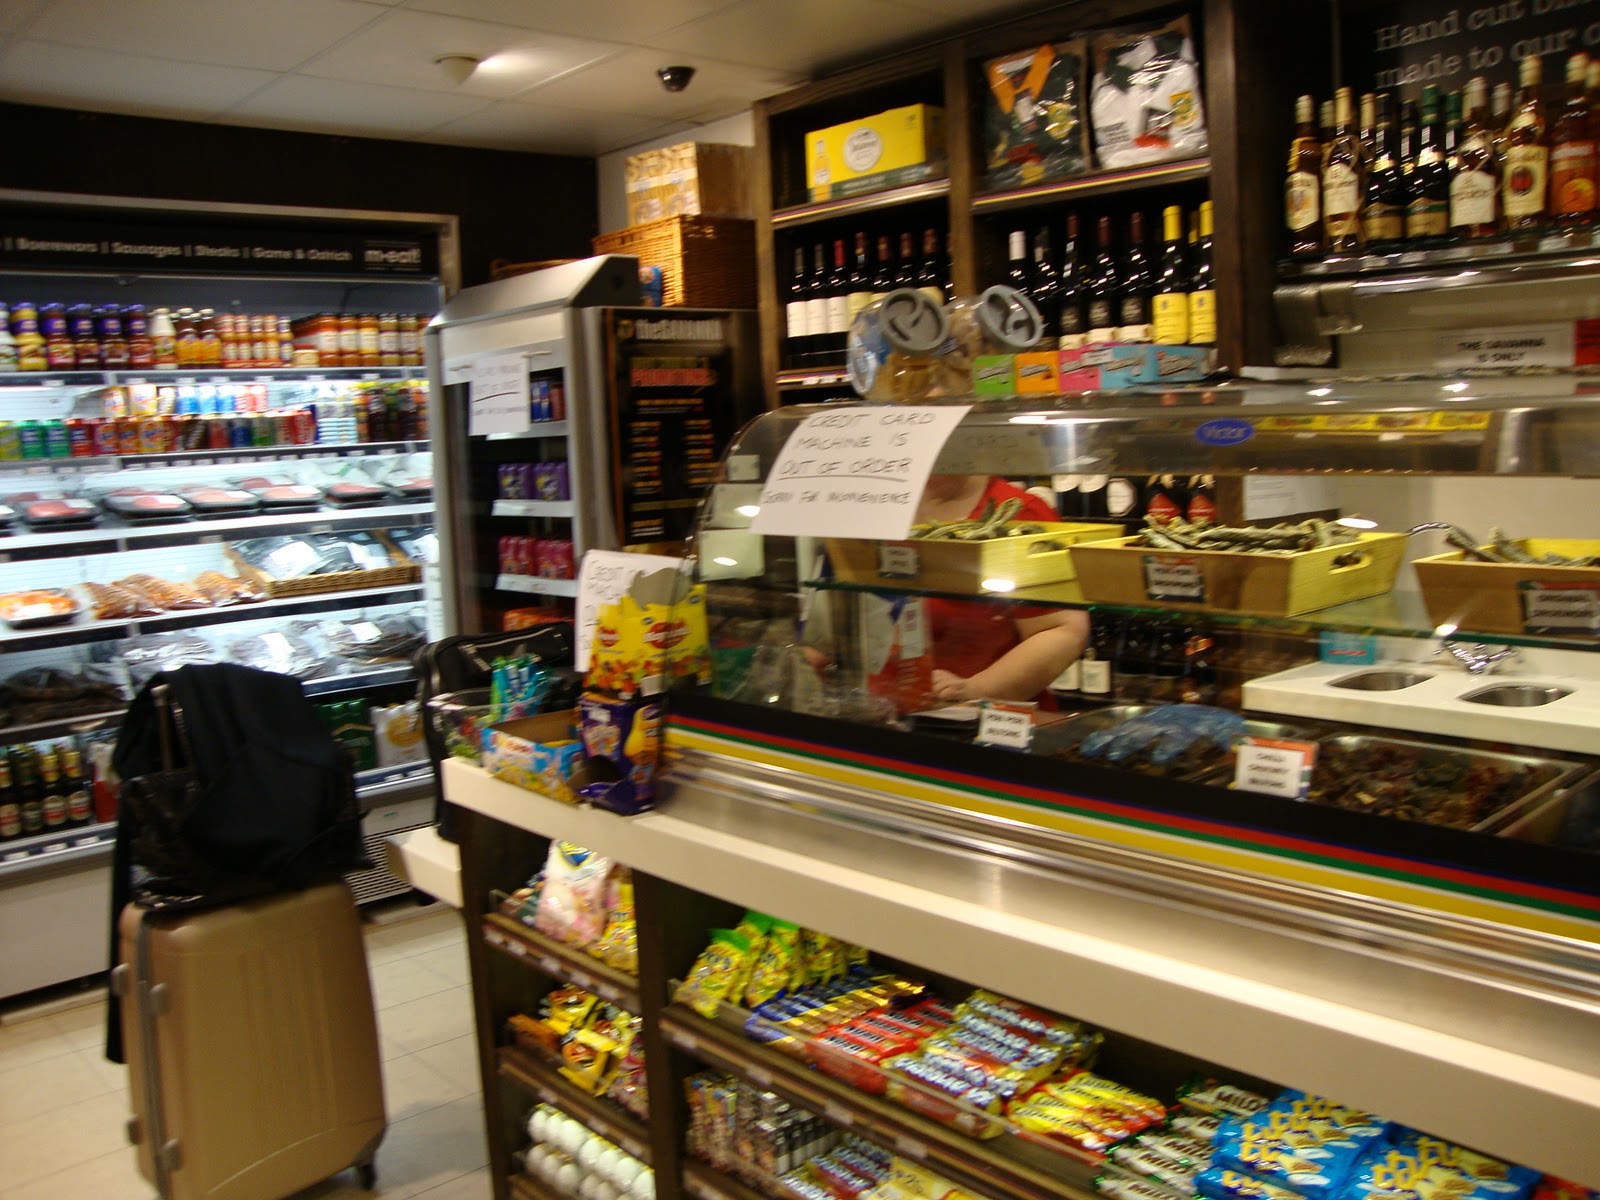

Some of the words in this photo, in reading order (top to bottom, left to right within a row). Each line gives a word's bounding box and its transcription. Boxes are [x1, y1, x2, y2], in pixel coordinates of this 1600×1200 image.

[1374, 9, 1461, 52] Hand
[1466, 0, 1527, 31] cut
[1375, 52, 1463, 89] made
[1469, 45, 1504, 70] to
[1510, 27, 1577, 62] our
[111, 241, 182, 258] Sausages
[194, 245, 240, 259] Steaks
[252, 247, 292, 260] Game
[1457, 341, 1482, 351] THE
[808, 414, 871, 428] CREDIT
[879, 413, 936, 427] CARD
[796, 436, 872, 450] MACHINE
[888, 432, 910, 447] IS
[779, 459, 816, 475] OUT
[819, 461, 843, 474] OF
[851, 458, 914, 473] ORDER
